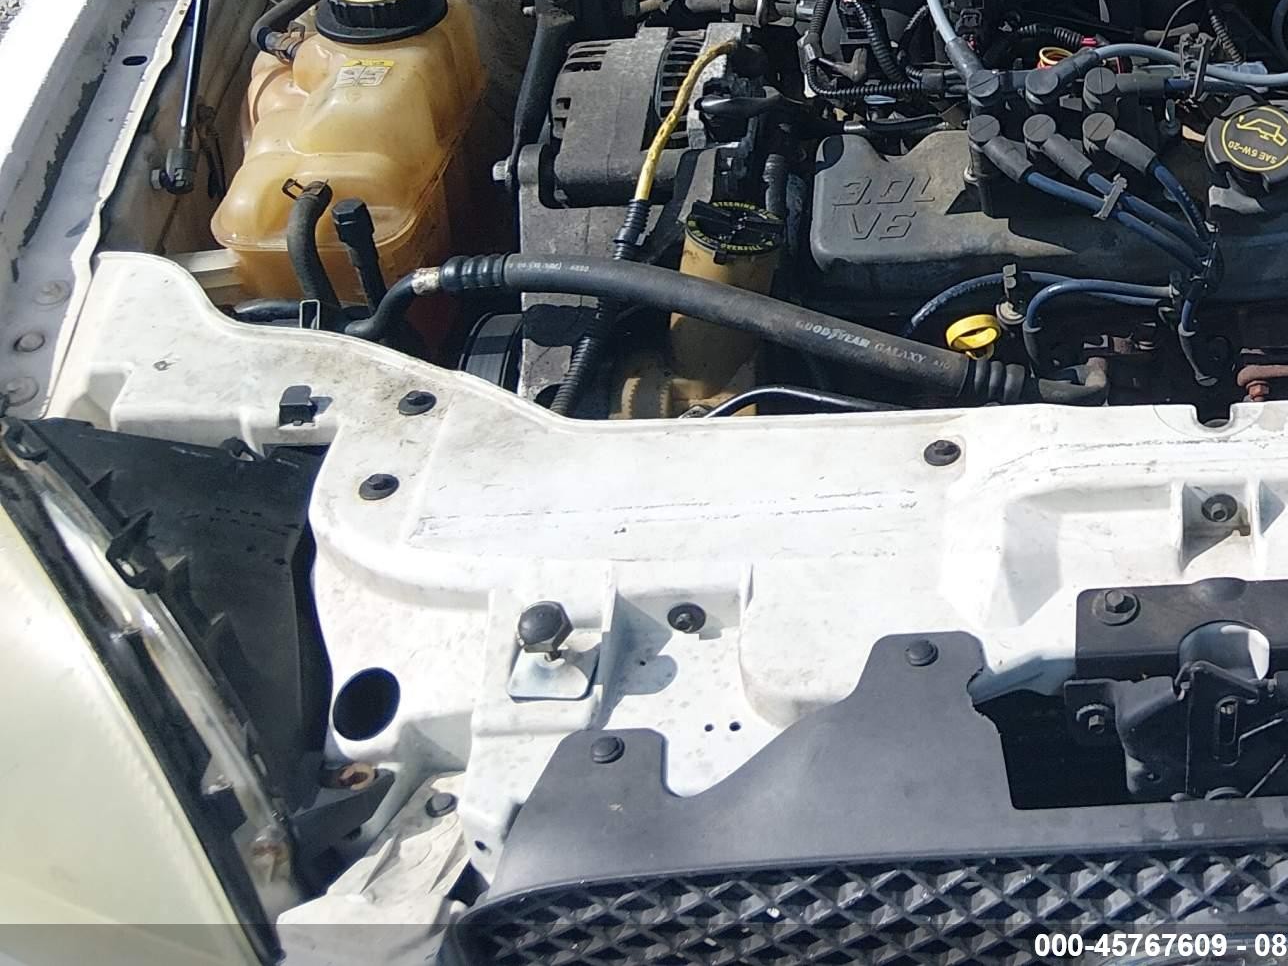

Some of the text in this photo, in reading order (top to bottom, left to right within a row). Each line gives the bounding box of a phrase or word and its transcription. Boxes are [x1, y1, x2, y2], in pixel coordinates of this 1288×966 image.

[1258, 151, 1278, 165] SAE
[711, 200, 757, 211] STEERING
[832, 175, 936, 206] 3.0L
[850, 211, 917, 241] V6
[795, 319, 871, 349] GOODYEAR
[874, 341, 928, 364] GALAXY
